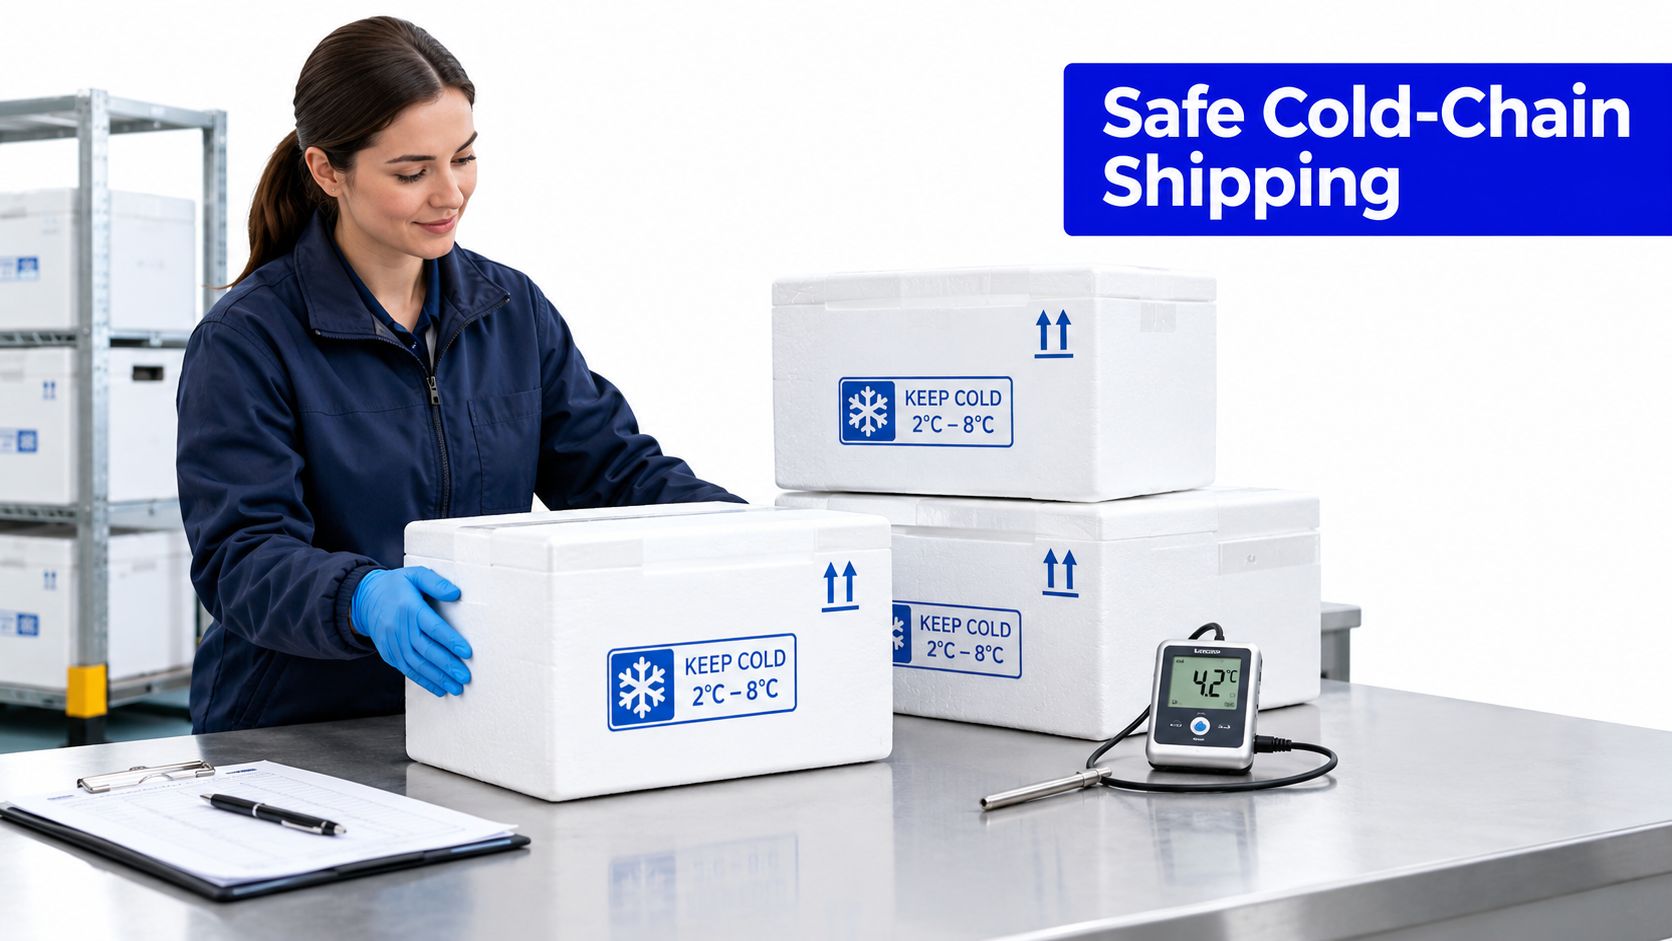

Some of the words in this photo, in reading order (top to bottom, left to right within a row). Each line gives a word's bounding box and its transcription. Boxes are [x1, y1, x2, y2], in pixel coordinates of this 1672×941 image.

[905, 389, 950, 407] KEEP
[954, 389, 1002, 407] COLD
[912, 414, 943, 434] 2°C
[963, 414, 995, 434] 8°C
[920, 614, 962, 634] KEEP
[966, 618, 1012, 638] COLD
[685, 653, 733, 676] KEEP
[737, 648, 787, 671] COLD
[926, 639, 956, 660] 2°C
[974, 644, 1004, 665] 8°C
[692, 683, 725, 707] 2°C
[746, 677, 779, 701] 8°C
